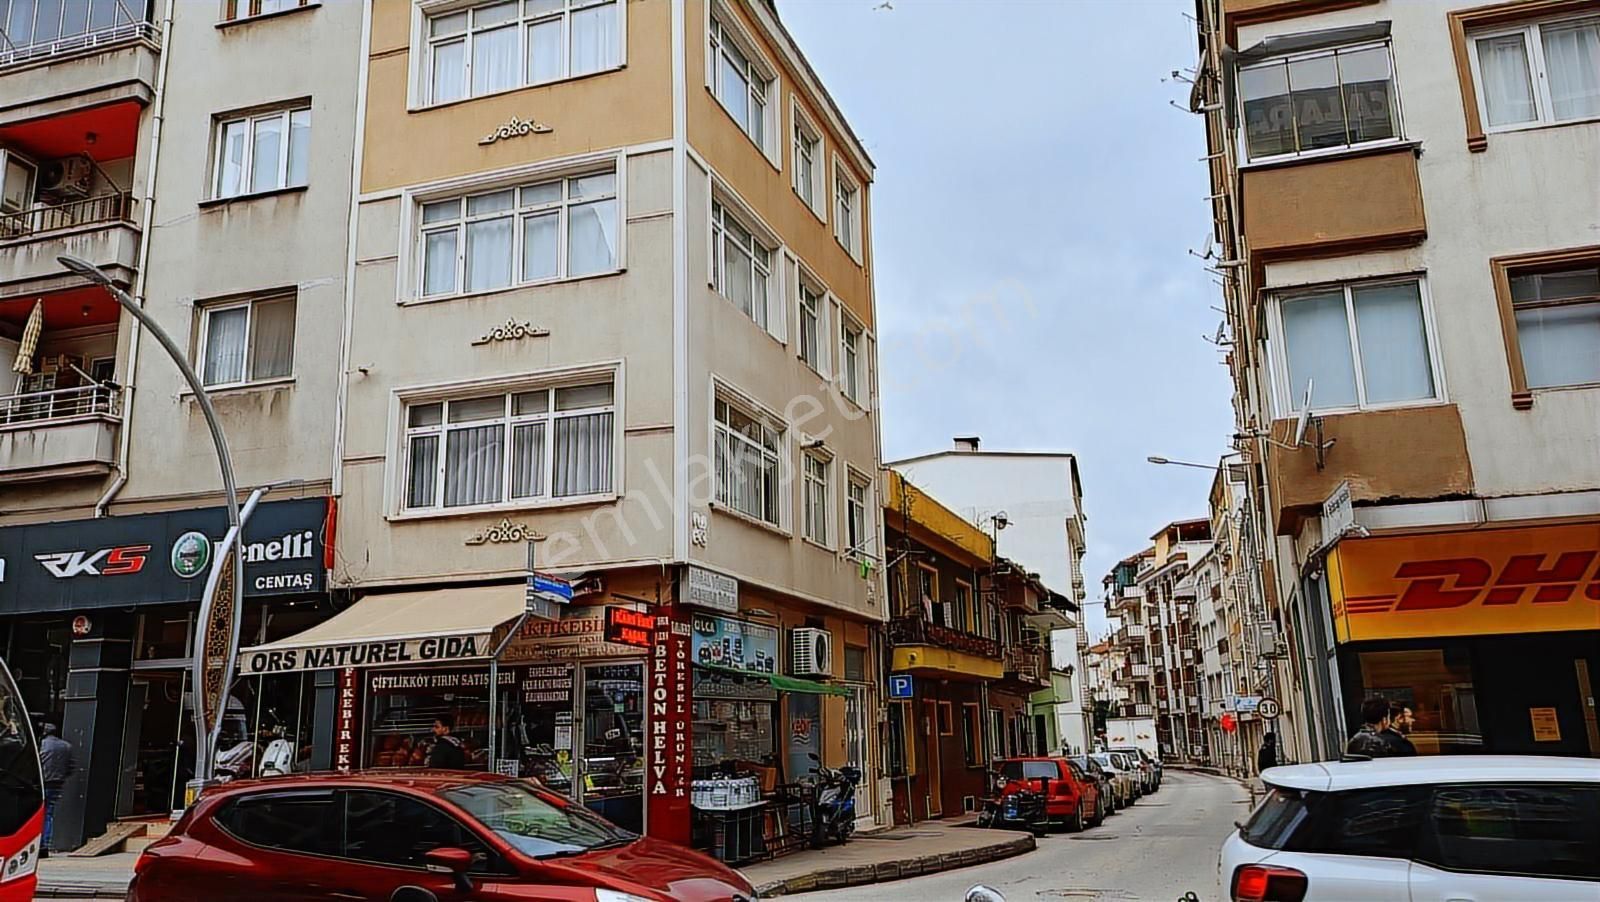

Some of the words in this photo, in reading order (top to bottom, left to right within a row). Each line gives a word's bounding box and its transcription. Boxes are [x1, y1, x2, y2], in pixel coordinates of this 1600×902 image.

[34, 545, 151, 578] RKS
[255, 573, 313, 591] CENTAŞ
[1394, 550, 1600, 611] DH
[251, 651, 297, 672] ORS
[304, 642, 411, 667] NATUREL
[419, 637, 478, 659] GIDA
[496, 669, 516, 685] ERİ
[653, 645, 668, 716] BETON
[895, 679, 907, 694] P
[1261, 702, 1276, 713] 30
[652, 721, 667, 794] HELVA
